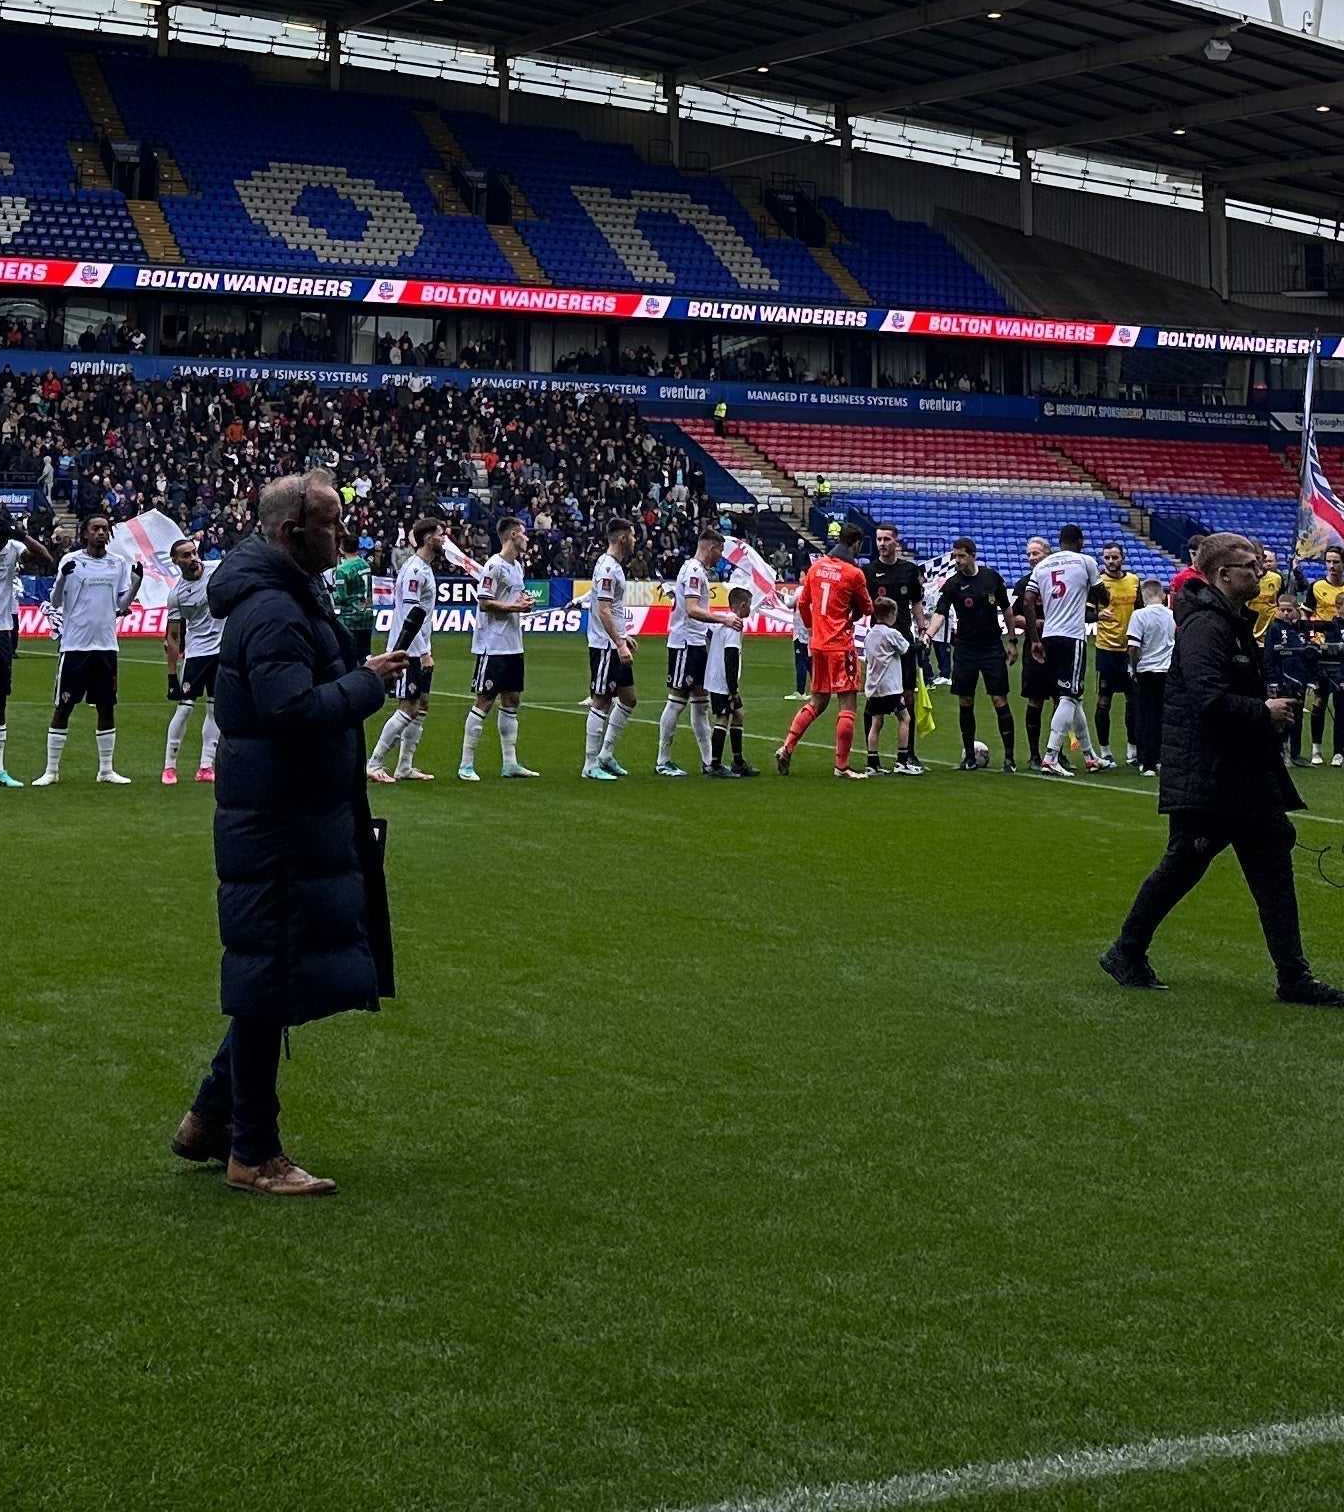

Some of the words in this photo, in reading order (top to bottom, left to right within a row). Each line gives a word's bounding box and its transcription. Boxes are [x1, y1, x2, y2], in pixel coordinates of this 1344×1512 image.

[135, 269, 219, 290] BOLTON
[223, 274, 352, 297] WANDERERS
[420, 285, 495, 306] BOLTON
[499, 290, 617, 312] WANDERERS
[688, 301, 756, 321] BOLTON
[759, 305, 868, 327] WANDERERS
[928, 316, 992, 335] BOLTON
[995, 320, 1096, 341] WANDERERS
[1157, 331, 1216, 350] BOLTON
[1219, 334, 1321, 355] WANDERERS
[70, 359, 125, 377] eventura
[174, 365, 234, 378] ANAGED
[236, 367, 247, 378] IT
[319, 371, 368, 383] SYSTEMS
[528, 379, 538, 390] IT
[660, 384, 706, 400] eventura
[747, 390, 797, 403] MANAGED
[800, 392, 808, 403] IT
[820, 393, 866, 406] BUSINESS
[867, 395, 908, 407] SYSTEMS
[919, 397, 961, 412] eventura
[1051, 569, 1067, 600] 5
[820, 581, 831, 616] 1
